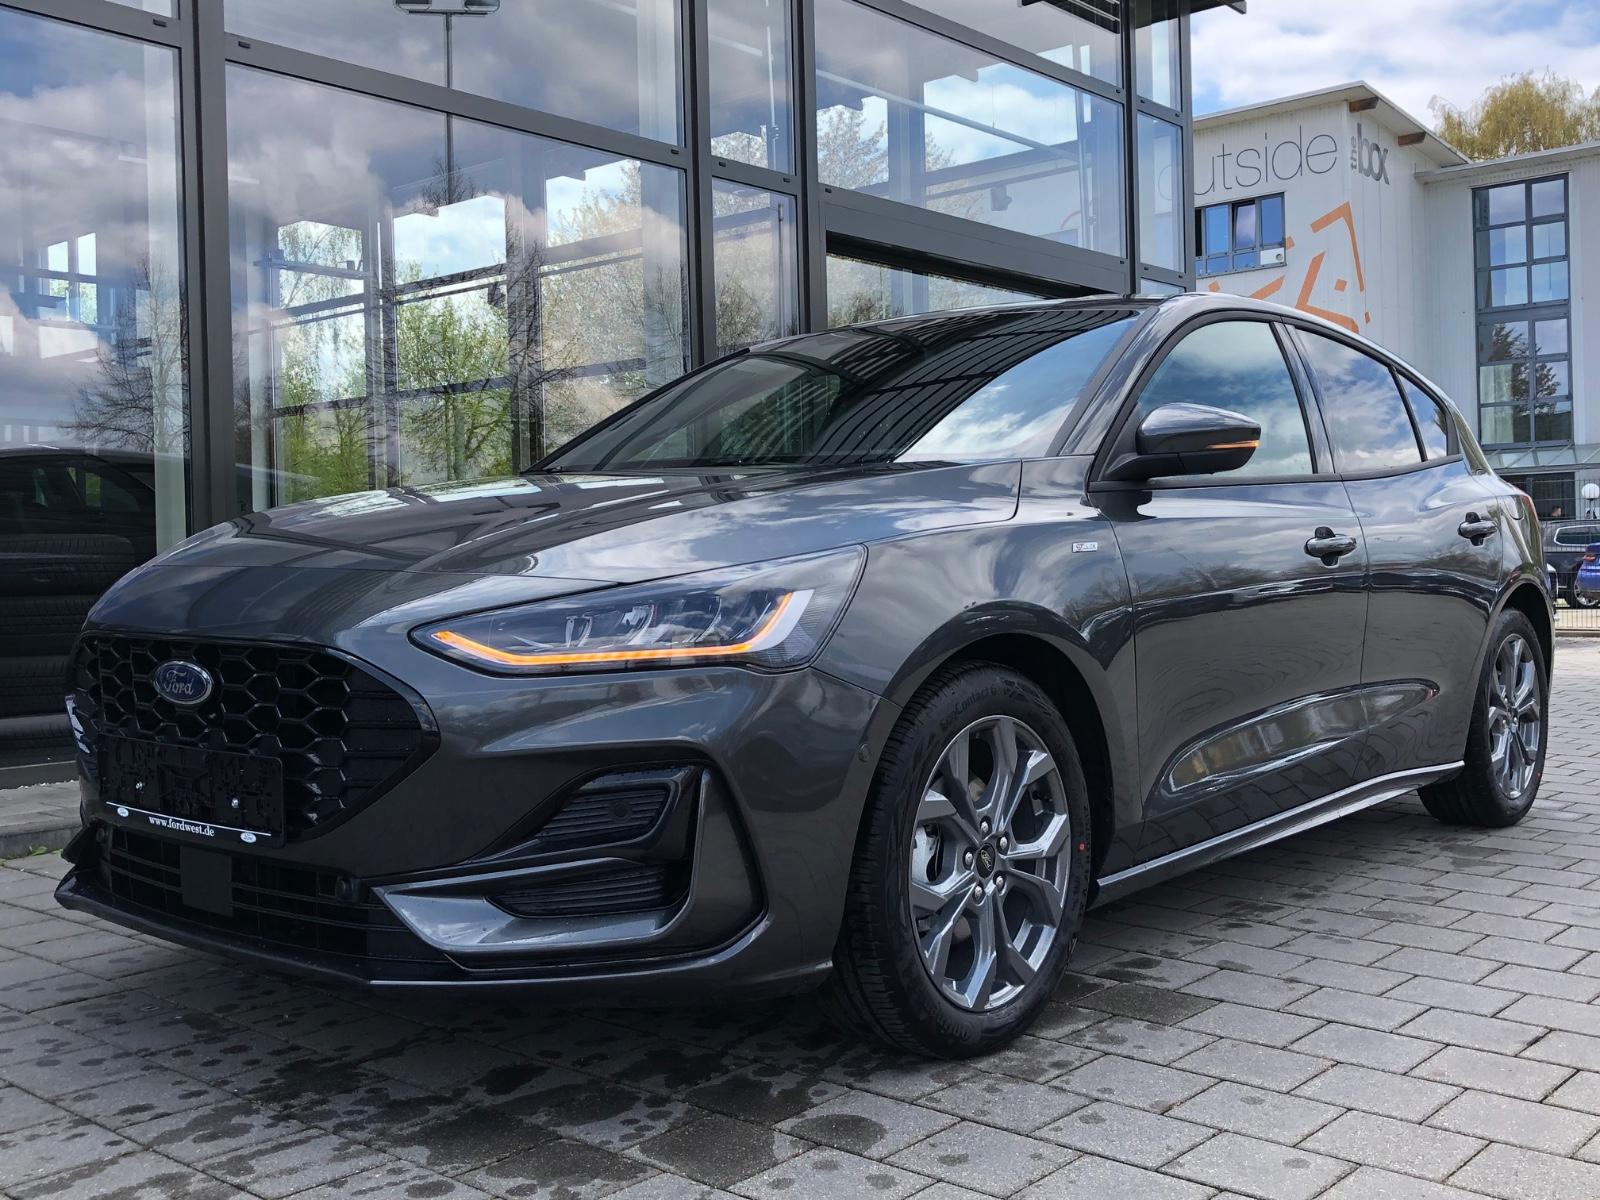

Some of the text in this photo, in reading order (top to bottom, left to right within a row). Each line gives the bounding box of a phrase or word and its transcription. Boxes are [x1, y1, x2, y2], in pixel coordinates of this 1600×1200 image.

[1356, 122, 1390, 185] box
[163, 669, 195, 696] Ford
[148, 814, 215, 837] www.fordwest.de
